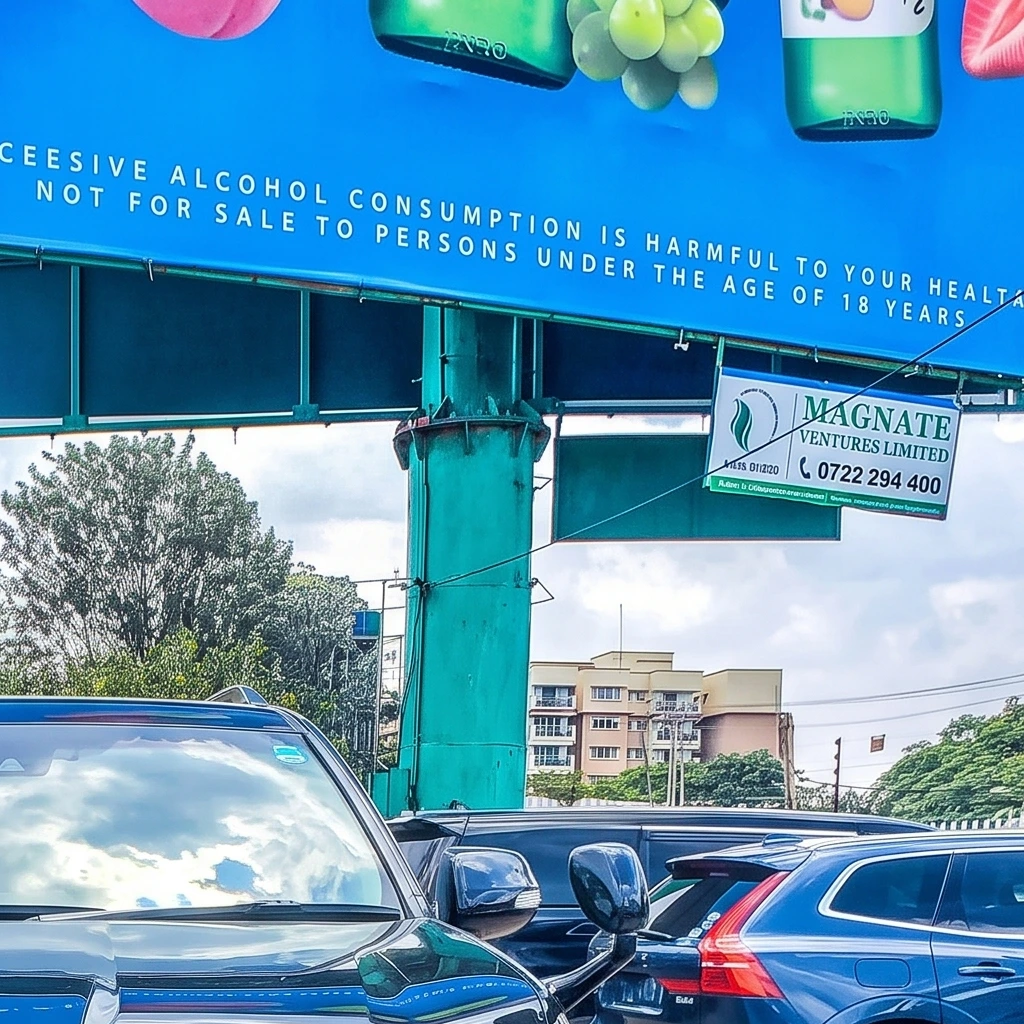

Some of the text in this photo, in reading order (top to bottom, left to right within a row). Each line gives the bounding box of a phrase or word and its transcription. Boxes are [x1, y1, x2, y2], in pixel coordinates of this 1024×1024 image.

[170, 165, 327, 204] ALCOHOL
[349, 189, 580, 241] CONSUMPTION
[601, 225, 626, 247] IS
[646, 232, 779, 271] HARMFUL
[796, 256, 827, 279] TO
[844, 264, 911, 292] YOUR
[37, 179, 965, 328] NOT FOR SALE TO PERSONS UNDER THE AGE OF 18 YEARS
[802, 395, 952, 442] MAGNATE
[799, 429, 950, 463] VENTURES LIMITED
[818, 461, 942, 495] 0722 294 400
